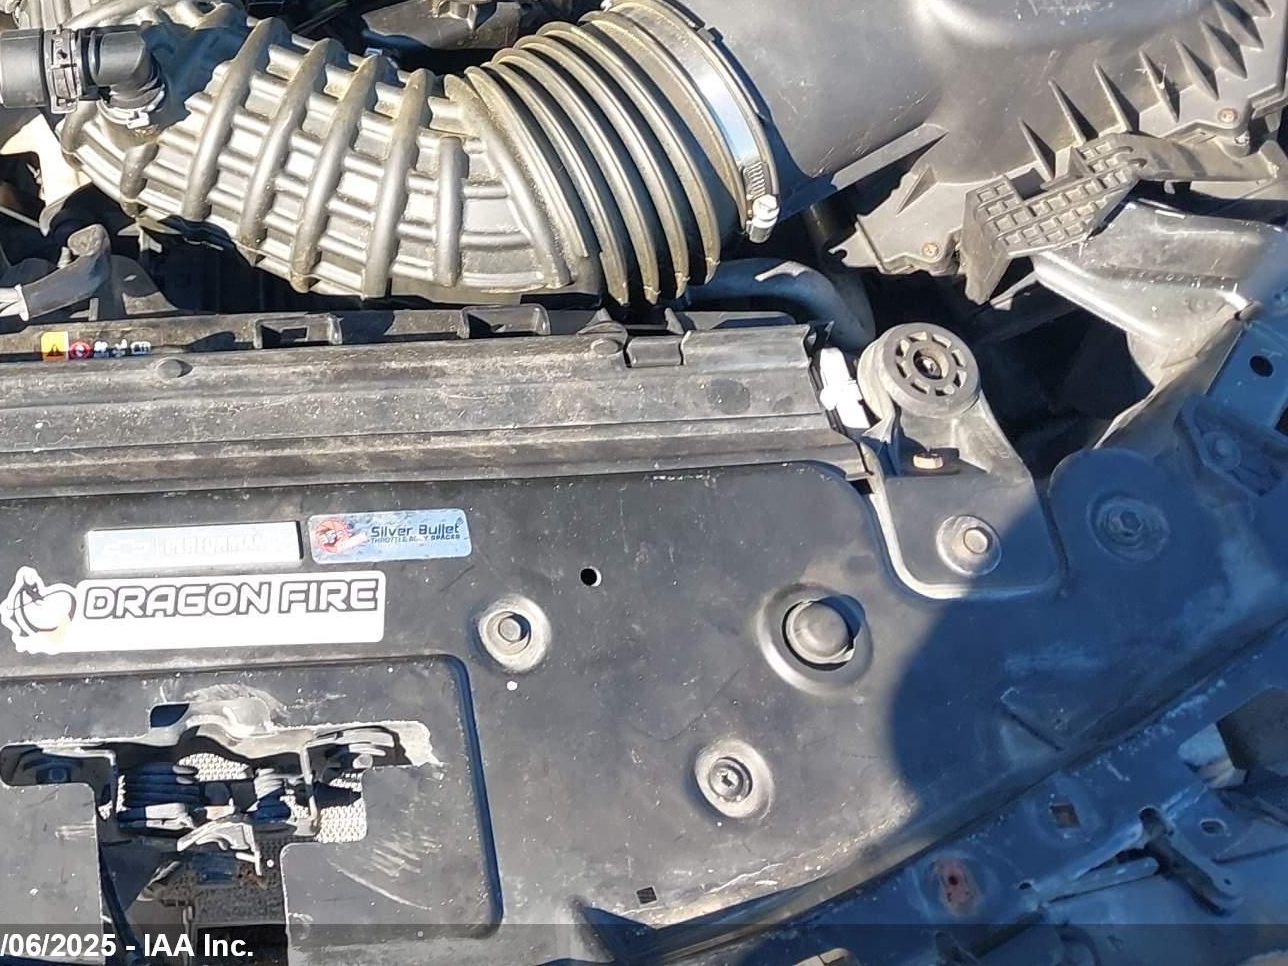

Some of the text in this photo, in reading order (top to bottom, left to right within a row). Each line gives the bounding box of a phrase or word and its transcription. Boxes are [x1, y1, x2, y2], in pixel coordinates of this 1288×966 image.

[371, 523, 459, 538] Silver Bullet
[84, 579, 378, 619] DRAGON FIRE
